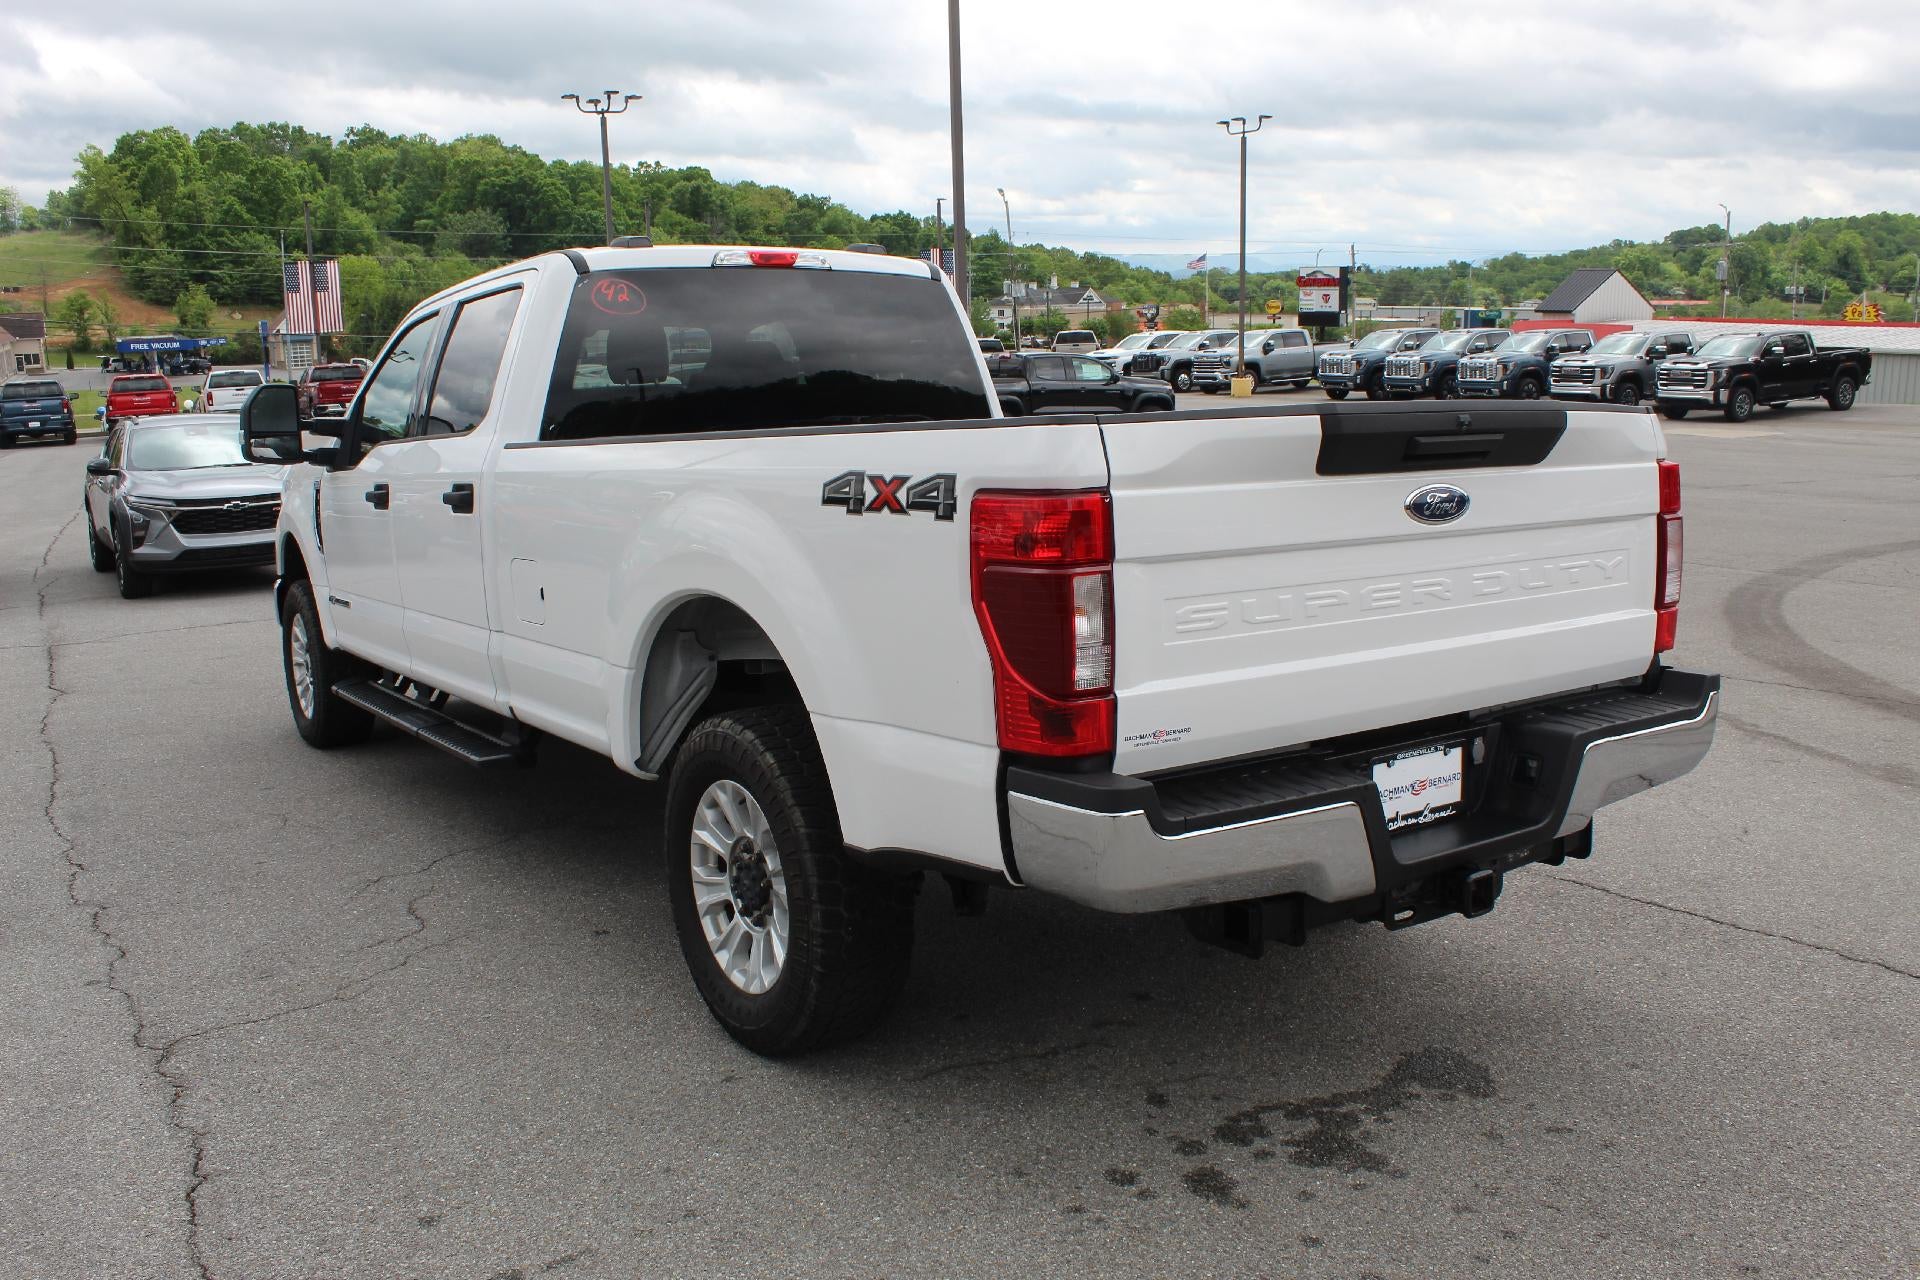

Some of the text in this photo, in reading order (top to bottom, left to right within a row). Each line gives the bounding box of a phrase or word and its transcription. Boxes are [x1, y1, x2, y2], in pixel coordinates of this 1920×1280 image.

[600, 281, 630, 303] 42
[1423, 492, 1459, 516] Ford
[1175, 555, 1624, 634] SUPER DUTY
[1165, 727, 1192, 736] BERNARD
[1379, 787, 1410, 798] ACHMAN
[1428, 773, 1461, 788] BERNARD
[1386, 811, 1419, 831] achman
